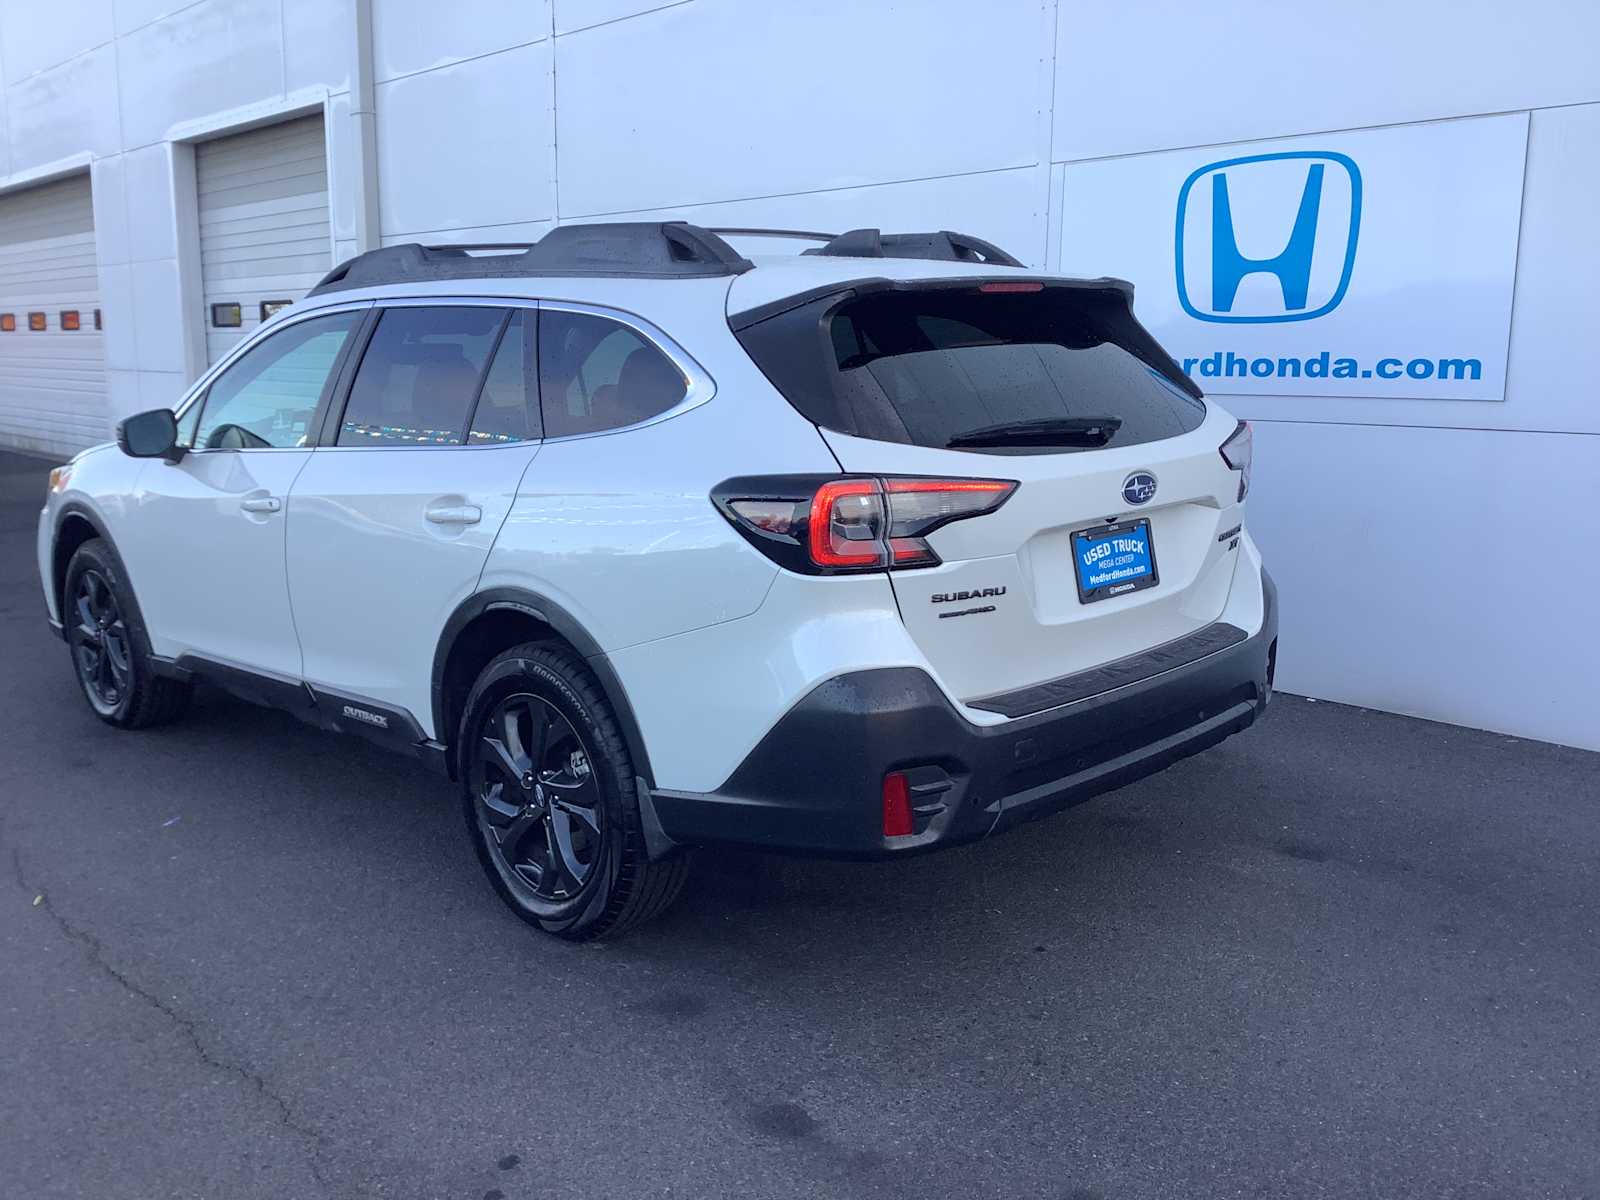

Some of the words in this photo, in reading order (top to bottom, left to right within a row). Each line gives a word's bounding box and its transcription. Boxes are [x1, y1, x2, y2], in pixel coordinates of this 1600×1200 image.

[1172, 352, 1482, 380] rdhonda.com
[1083, 542, 1111, 566] USED
[1112, 538, 1144, 554] TRUCK
[1098, 559, 1115, 569] MEGA
[1115, 553, 1135, 566] CENTER
[1089, 565, 1146, 585] MedfordHonda.com
[931, 586, 1007, 603] SUBARU
[343, 705, 389, 728] OUTBACK
